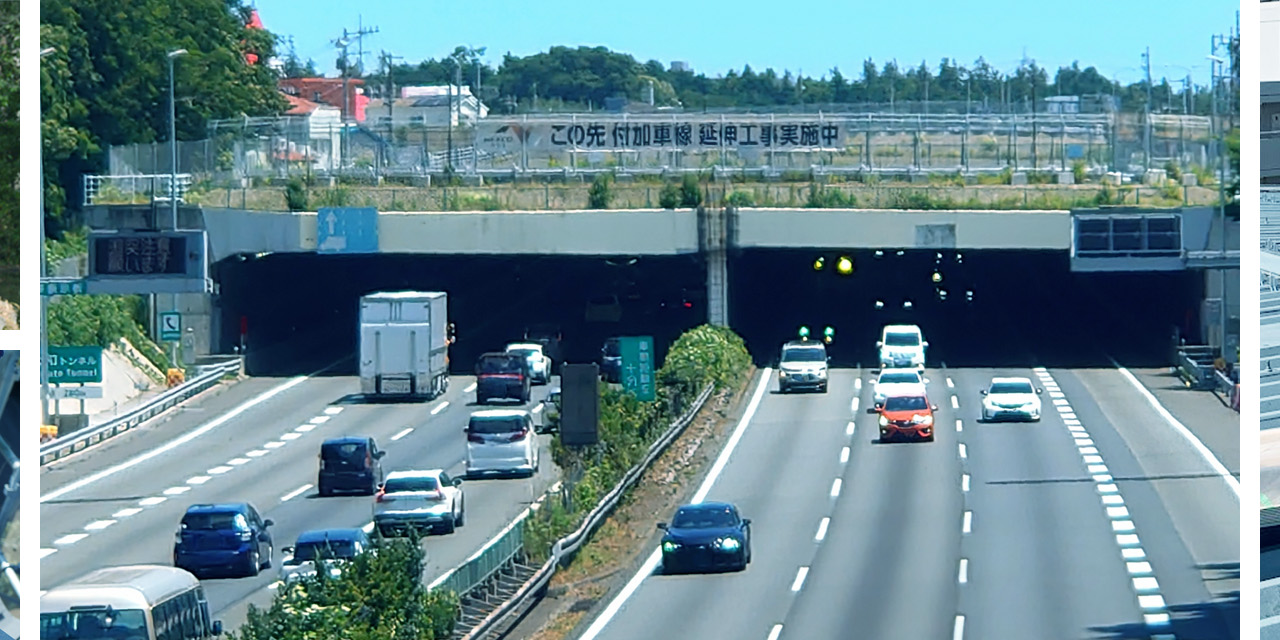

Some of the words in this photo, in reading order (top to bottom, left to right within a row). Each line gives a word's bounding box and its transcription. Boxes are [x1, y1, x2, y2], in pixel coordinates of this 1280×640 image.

[550, 123, 606, 148] この先
[612, 122, 693, 147] 付加車線
[698, 122, 839, 147] 延伸工事実施中
